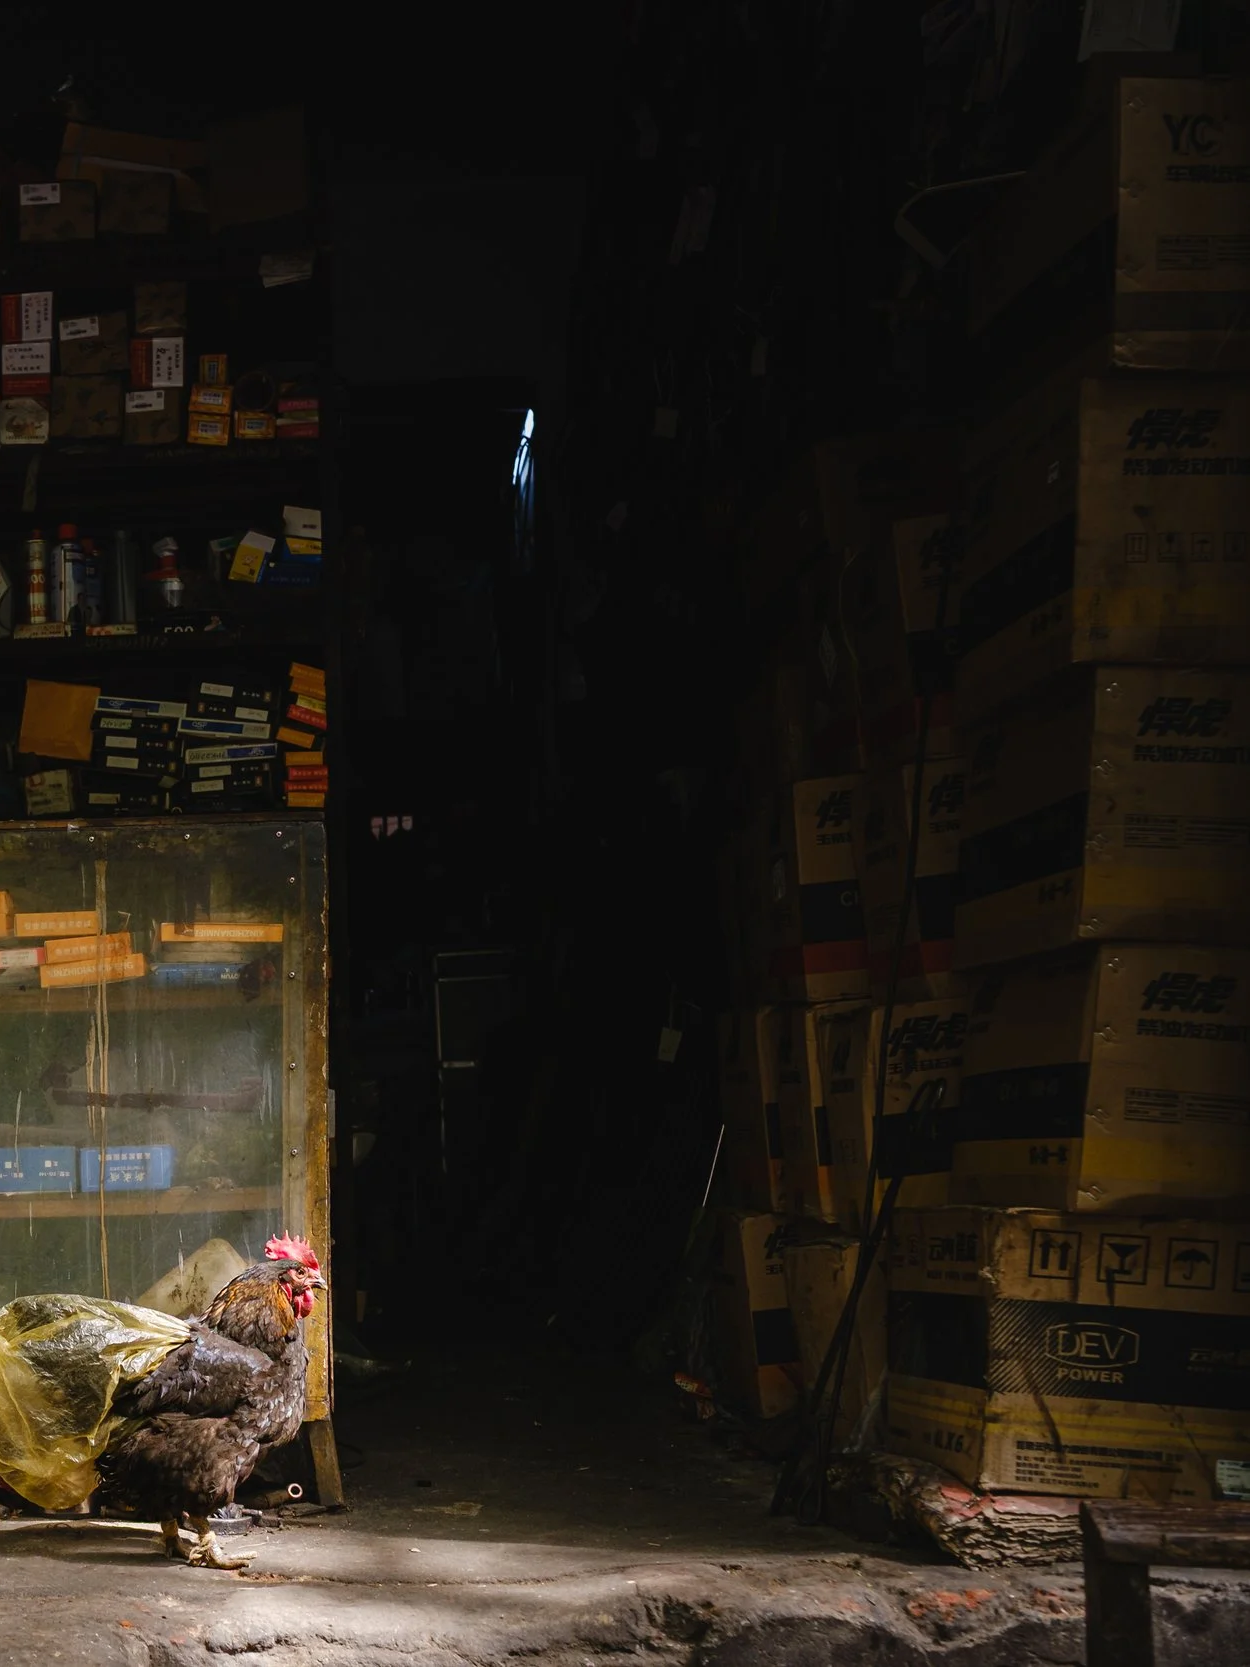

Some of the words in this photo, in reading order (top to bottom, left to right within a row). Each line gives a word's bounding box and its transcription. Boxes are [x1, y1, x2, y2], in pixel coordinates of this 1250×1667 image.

[1162, 113, 1221, 157] YC
[1125, 408, 1222, 450] 悍虎
[1122, 456, 1250, 477] 柴油发动机
[1135, 696, 1233, 738] 悍虎
[1133, 743, 1250, 764] 柴油发动机
[1141, 972, 1237, 1012] 悍虎
[1057, 1330, 1125, 1361] DEV
[1057, 1367, 1125, 1385] POWER
